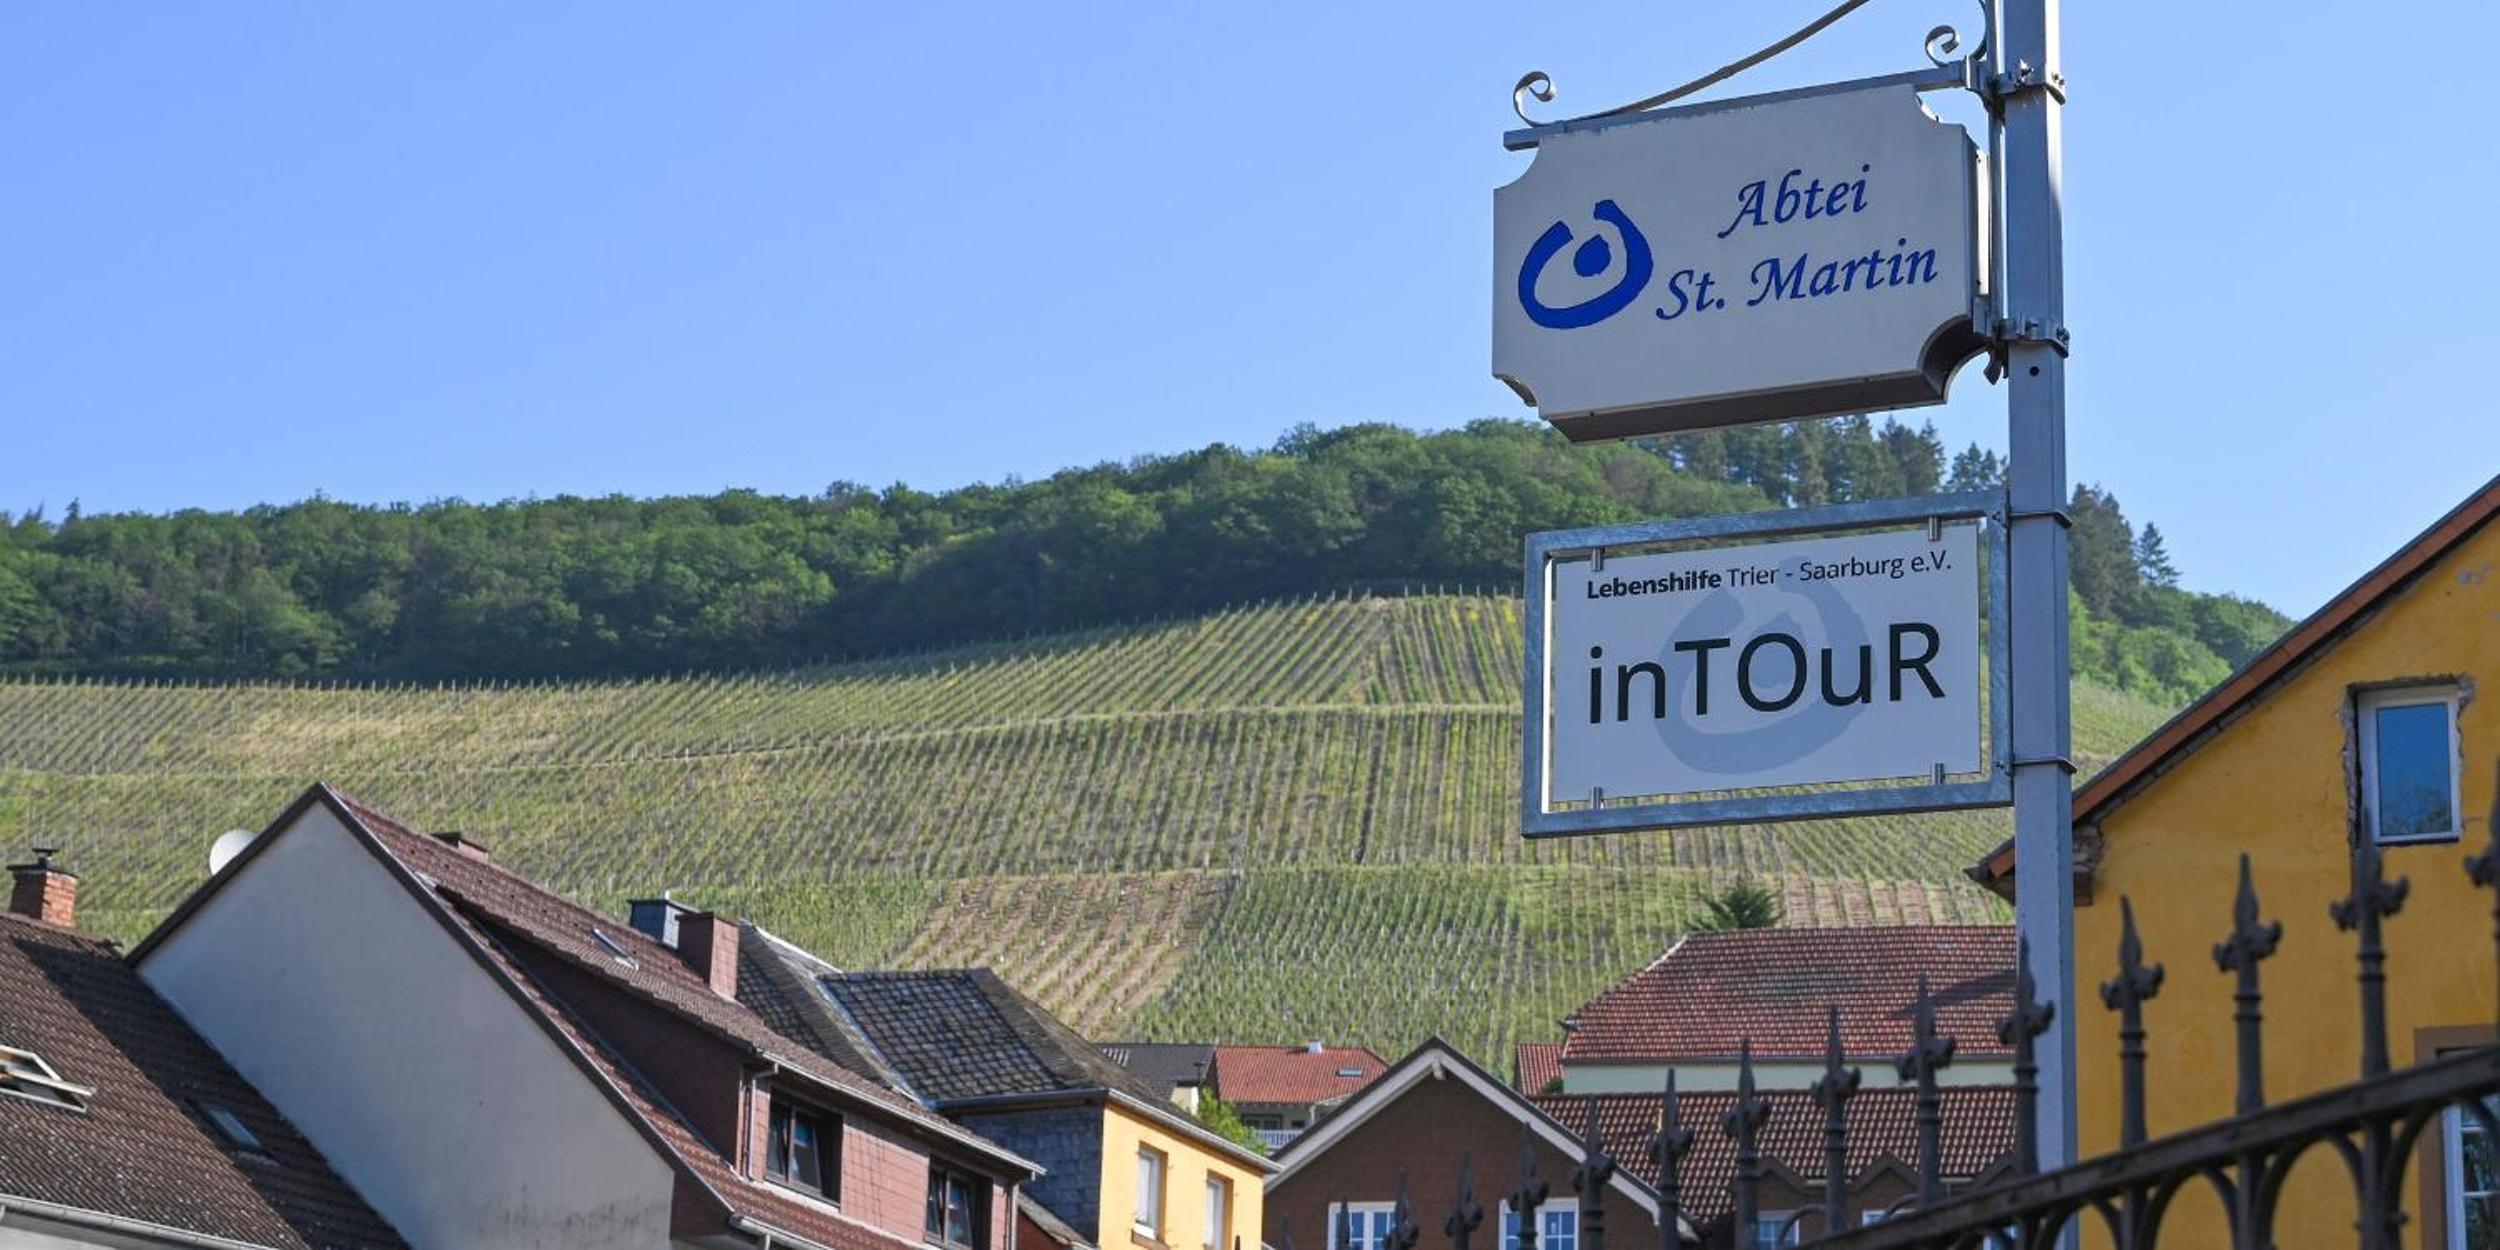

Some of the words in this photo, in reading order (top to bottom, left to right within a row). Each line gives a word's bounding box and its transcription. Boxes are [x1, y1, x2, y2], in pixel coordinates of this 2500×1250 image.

[1717, 164, 1871, 239] Abtei
[1656, 269, 1725, 321] St.
[1747, 238, 1938, 307] Martin
[1587, 569, 1722, 599] Lebenshilfe
[1727, 565, 1780, 588] Trier
[1799, 554, 1905, 582] Saarburg
[1910, 550, 1952, 573] e.V.
[1590, 622, 1946, 724] inTOuR
